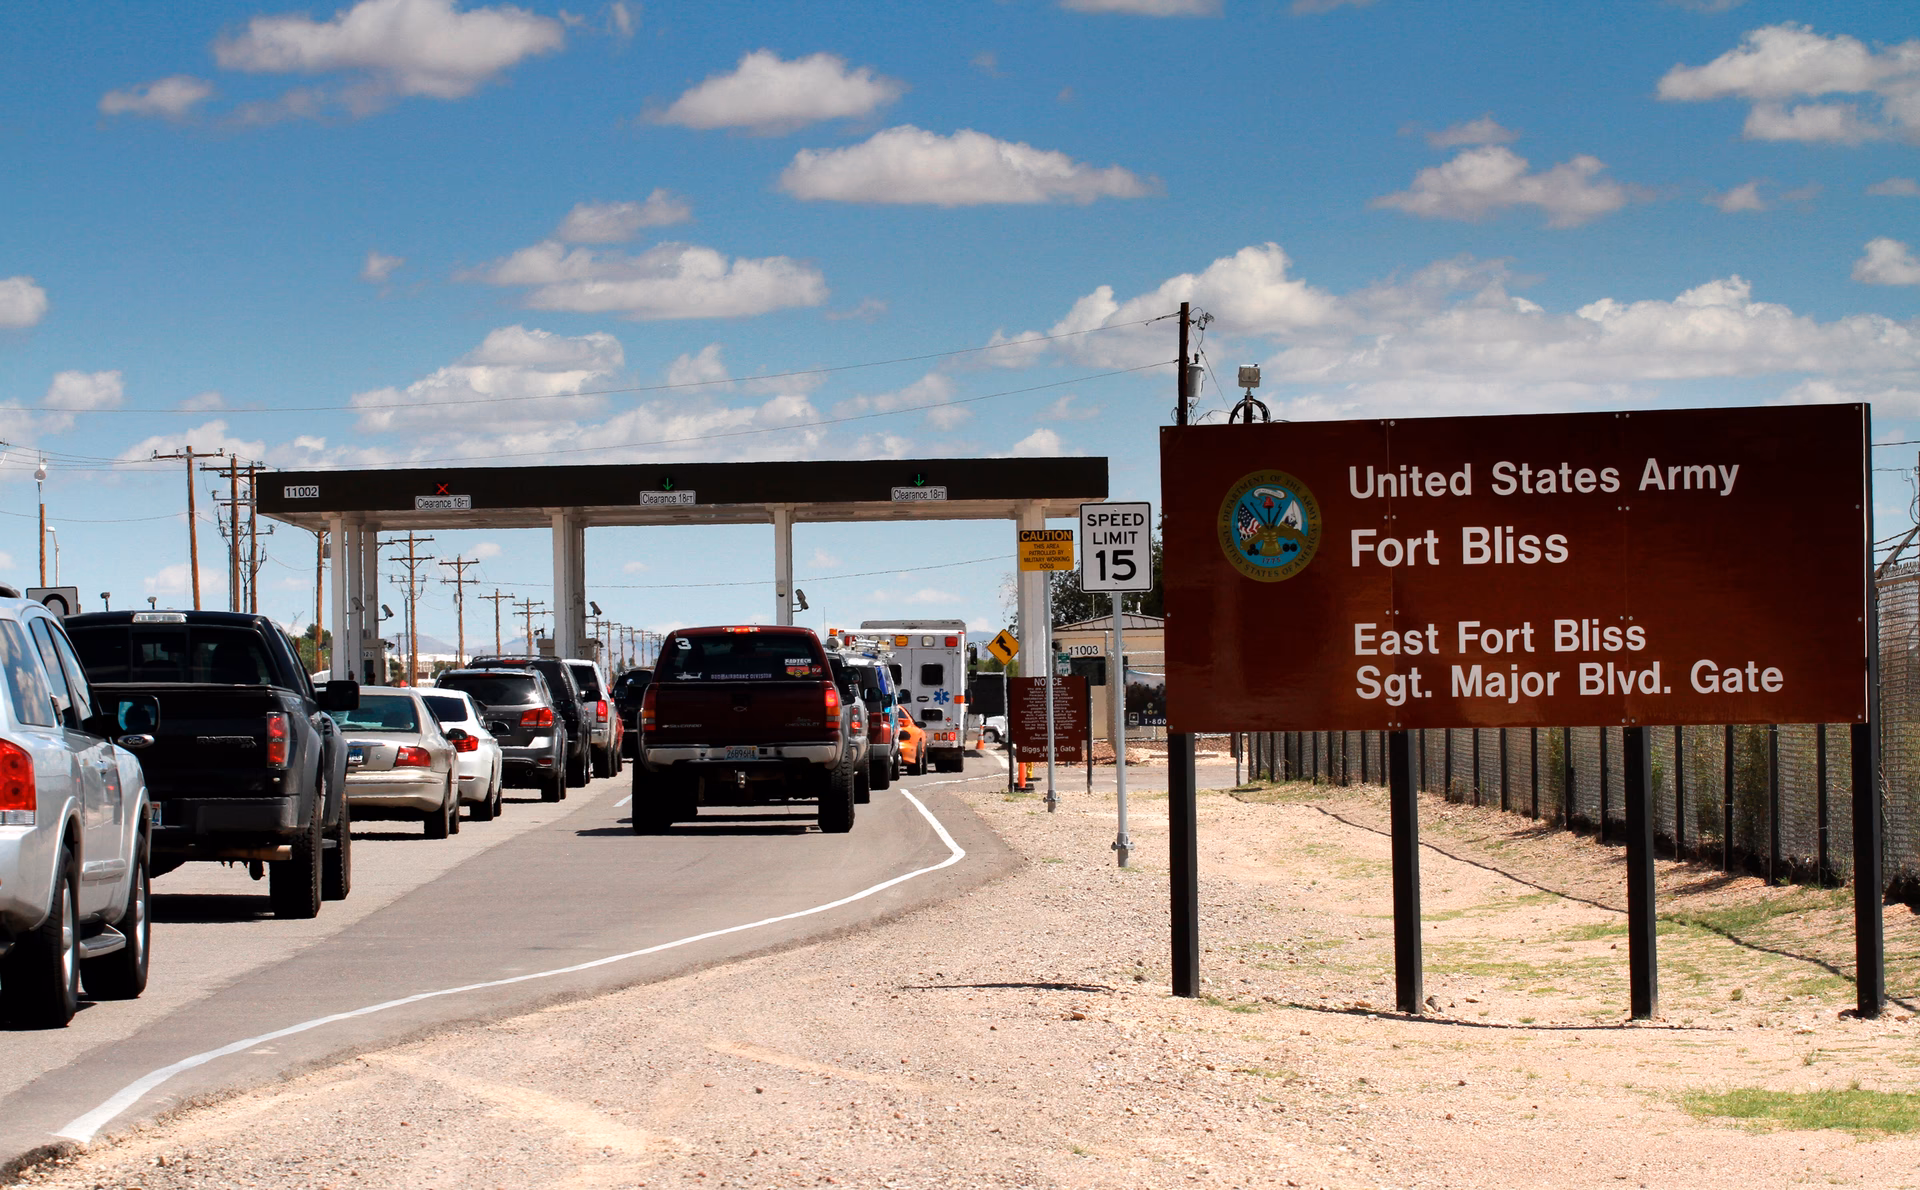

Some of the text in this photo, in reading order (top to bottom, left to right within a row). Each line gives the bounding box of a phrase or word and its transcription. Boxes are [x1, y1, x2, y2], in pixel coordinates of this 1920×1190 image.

[1349, 457, 1740, 499] United States Army
[285, 486, 318, 497] 11002
[893, 489, 944, 500] Clearance 18FT
[417, 497, 468, 508] Clearance 18FT
[642, 493, 693, 504] Clearance 18FT
[1223, 475, 1265, 522] DEPARTMENT
[1285, 480, 1303, 493] THE
[1301, 495, 1317, 520] ARMY
[1087, 513, 1144, 526] SPEED
[1021, 530, 1071, 541] CAUTION
[1093, 531, 1138, 545] LIMIT
[1223, 527, 1317, 577] UNITED STATES OF AMERICA
[1350, 526, 1569, 567] Fort Bliss
[1095, 550, 1137, 581] 15
[1354, 618, 1646, 655] East Fort Bliss
[675, 638, 692, 649] 3
[1068, 646, 1099, 655] 11003
[1034, 678, 1062, 686] NOCE
[1355, 659, 1784, 706] Sgt. Major Blvd. Gate
